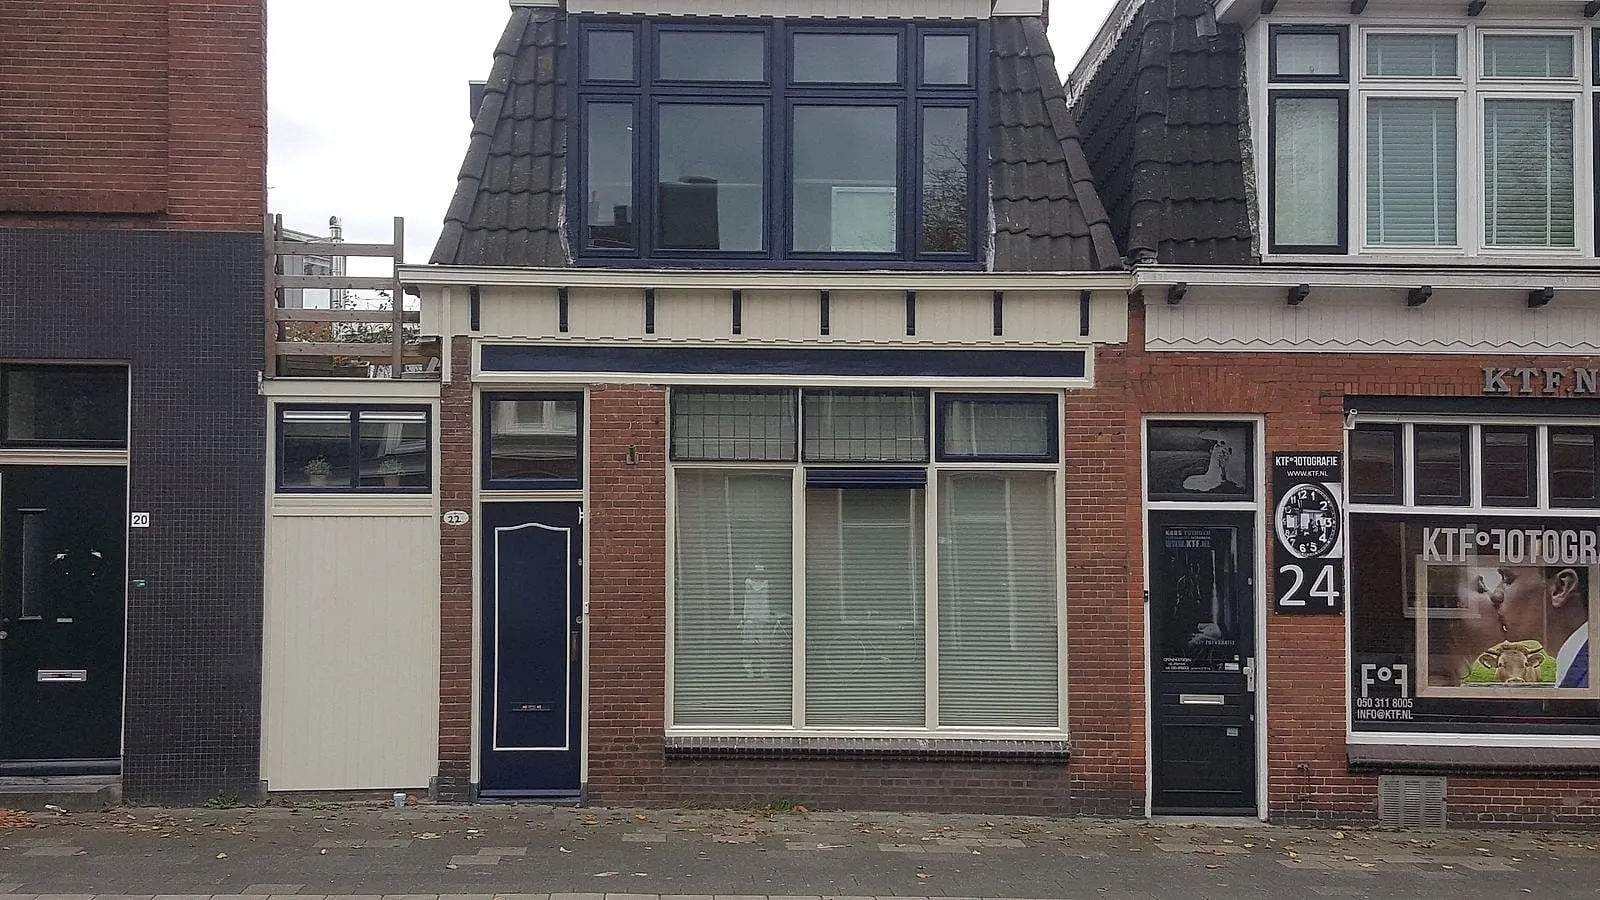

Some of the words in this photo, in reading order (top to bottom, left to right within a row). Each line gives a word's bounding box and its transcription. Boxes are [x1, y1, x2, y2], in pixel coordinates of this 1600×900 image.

[1320, 501, 1328, 511] 2
[133, 515, 148, 524] 20
[447, 515, 462, 523] 22
[1279, 564, 1340, 606] 24
[1357, 698, 1373, 708] 050
[1374, 698, 1389, 708] 311
[1392, 698, 1413, 708] 8005
[1357, 709, 1414, 720] INFO@KTF.NL
